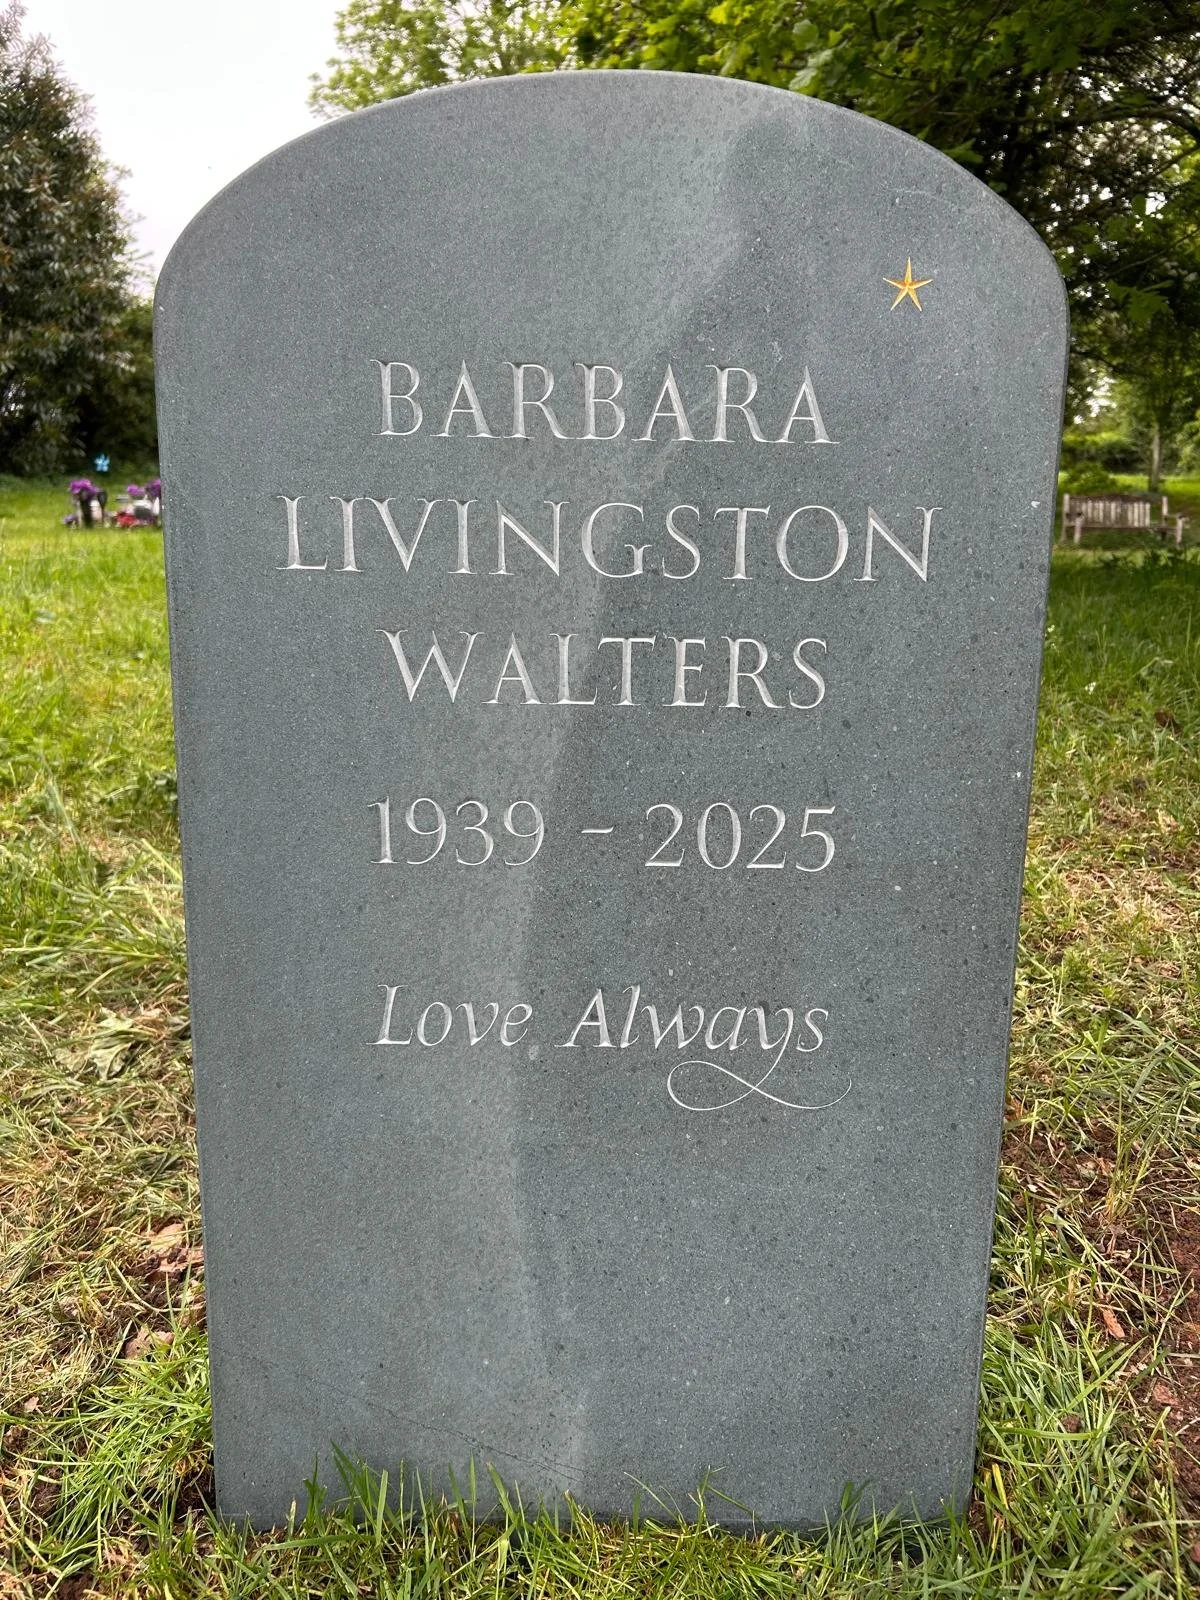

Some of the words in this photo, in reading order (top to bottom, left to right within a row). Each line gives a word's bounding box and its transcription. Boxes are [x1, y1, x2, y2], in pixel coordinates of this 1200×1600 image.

[370, 360, 840, 444] BARBARA
[276, 495, 943, 582] LIVINGSTON
[376, 629, 827, 710] WALTERS
[367, 796, 545, 867] 1939
[644, 803, 836, 872] 2025
[366, 984, 534, 1047] Love
[554, 984, 853, 1112] Always
